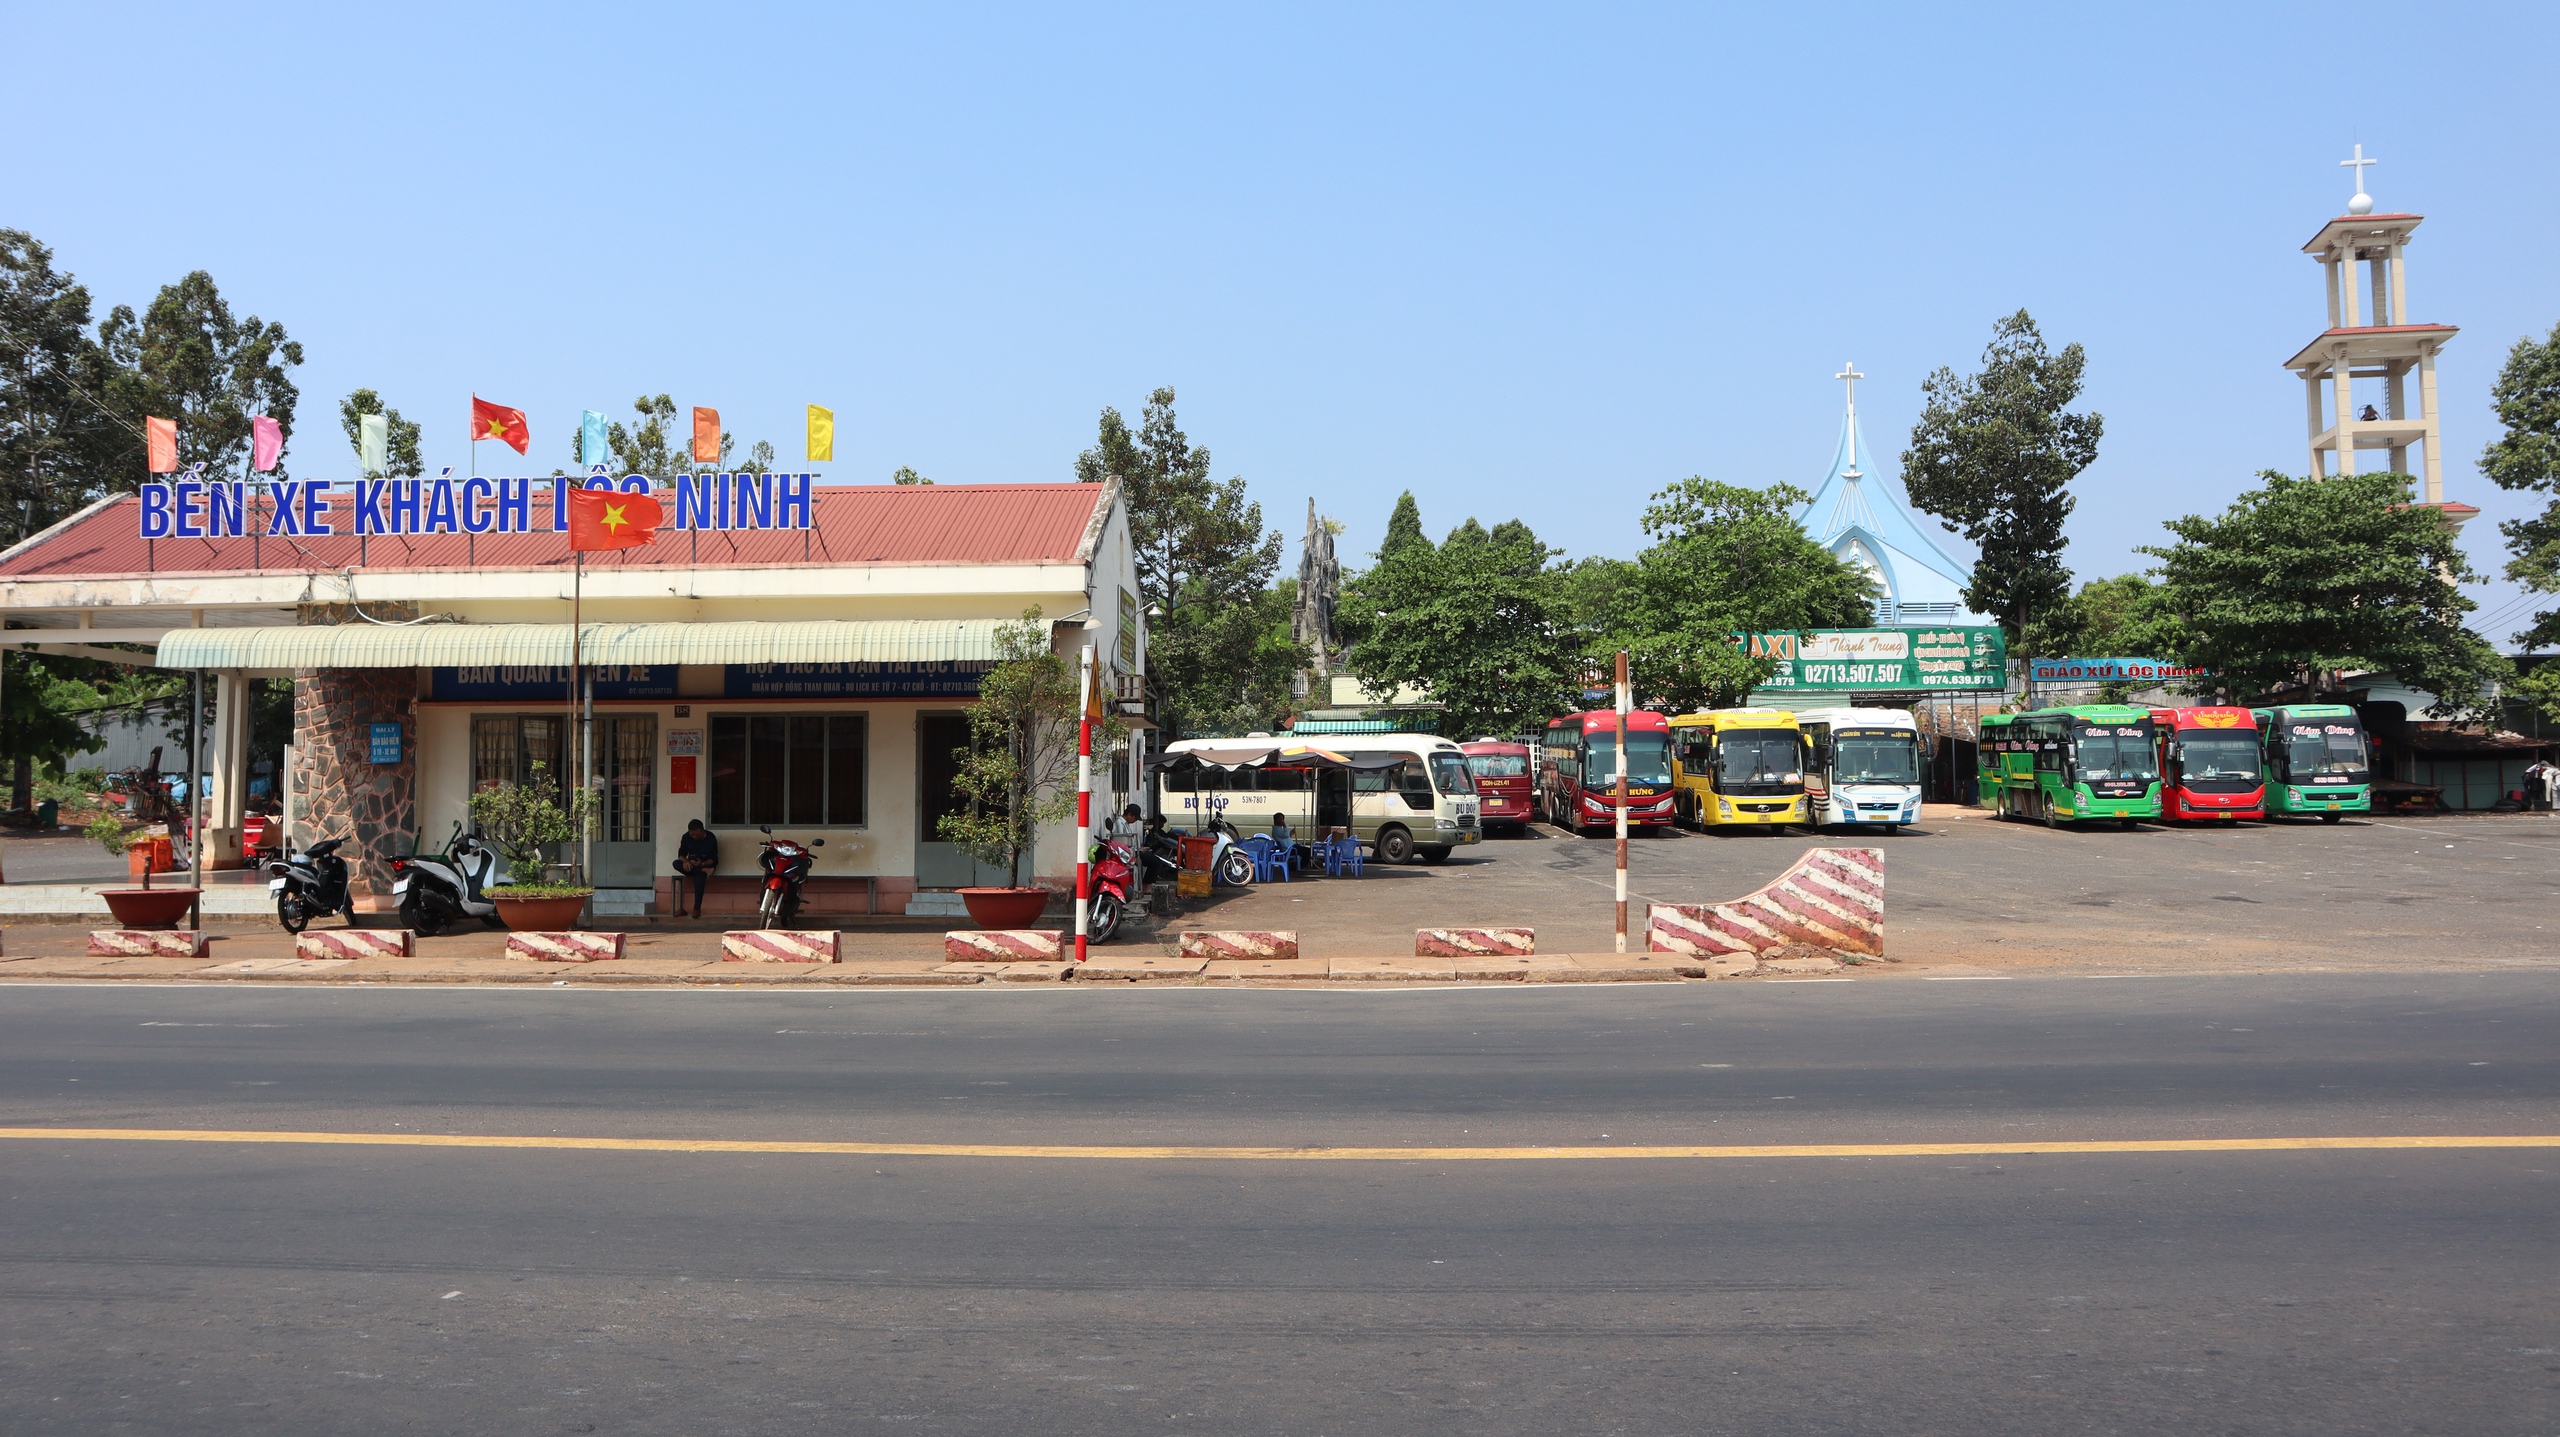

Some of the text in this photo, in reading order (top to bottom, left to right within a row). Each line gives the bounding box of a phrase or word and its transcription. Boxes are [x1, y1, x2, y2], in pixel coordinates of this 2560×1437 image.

[140, 462, 247, 538] BẾN
[267, 479, 334, 537] XE
[354, 466, 532, 535] KHÁCH
[674, 472, 813, 531] NINH
[1830, 637, 1865, 653] Thành
[1868, 636, 1903, 656] Trung
[1804, 664, 1903, 683] 02713.507.507
[2037, 662, 2083, 678] GIÁO
[2086, 662, 2114, 678] XỨ
[2117, 661, 2154, 680] LỘC
[804, 682, 822, 692] THAM
[823, 682, 840, 693] QUAN
[871, 683, 880, 692] XE
[892, 683, 896, 692] 7
[902, 683, 910, 692] 47
[1922, 675, 1994, 685] 0974.639.879
[676, 706, 689, 715] 68
[1629, 787, 1654, 796] HƯNG
